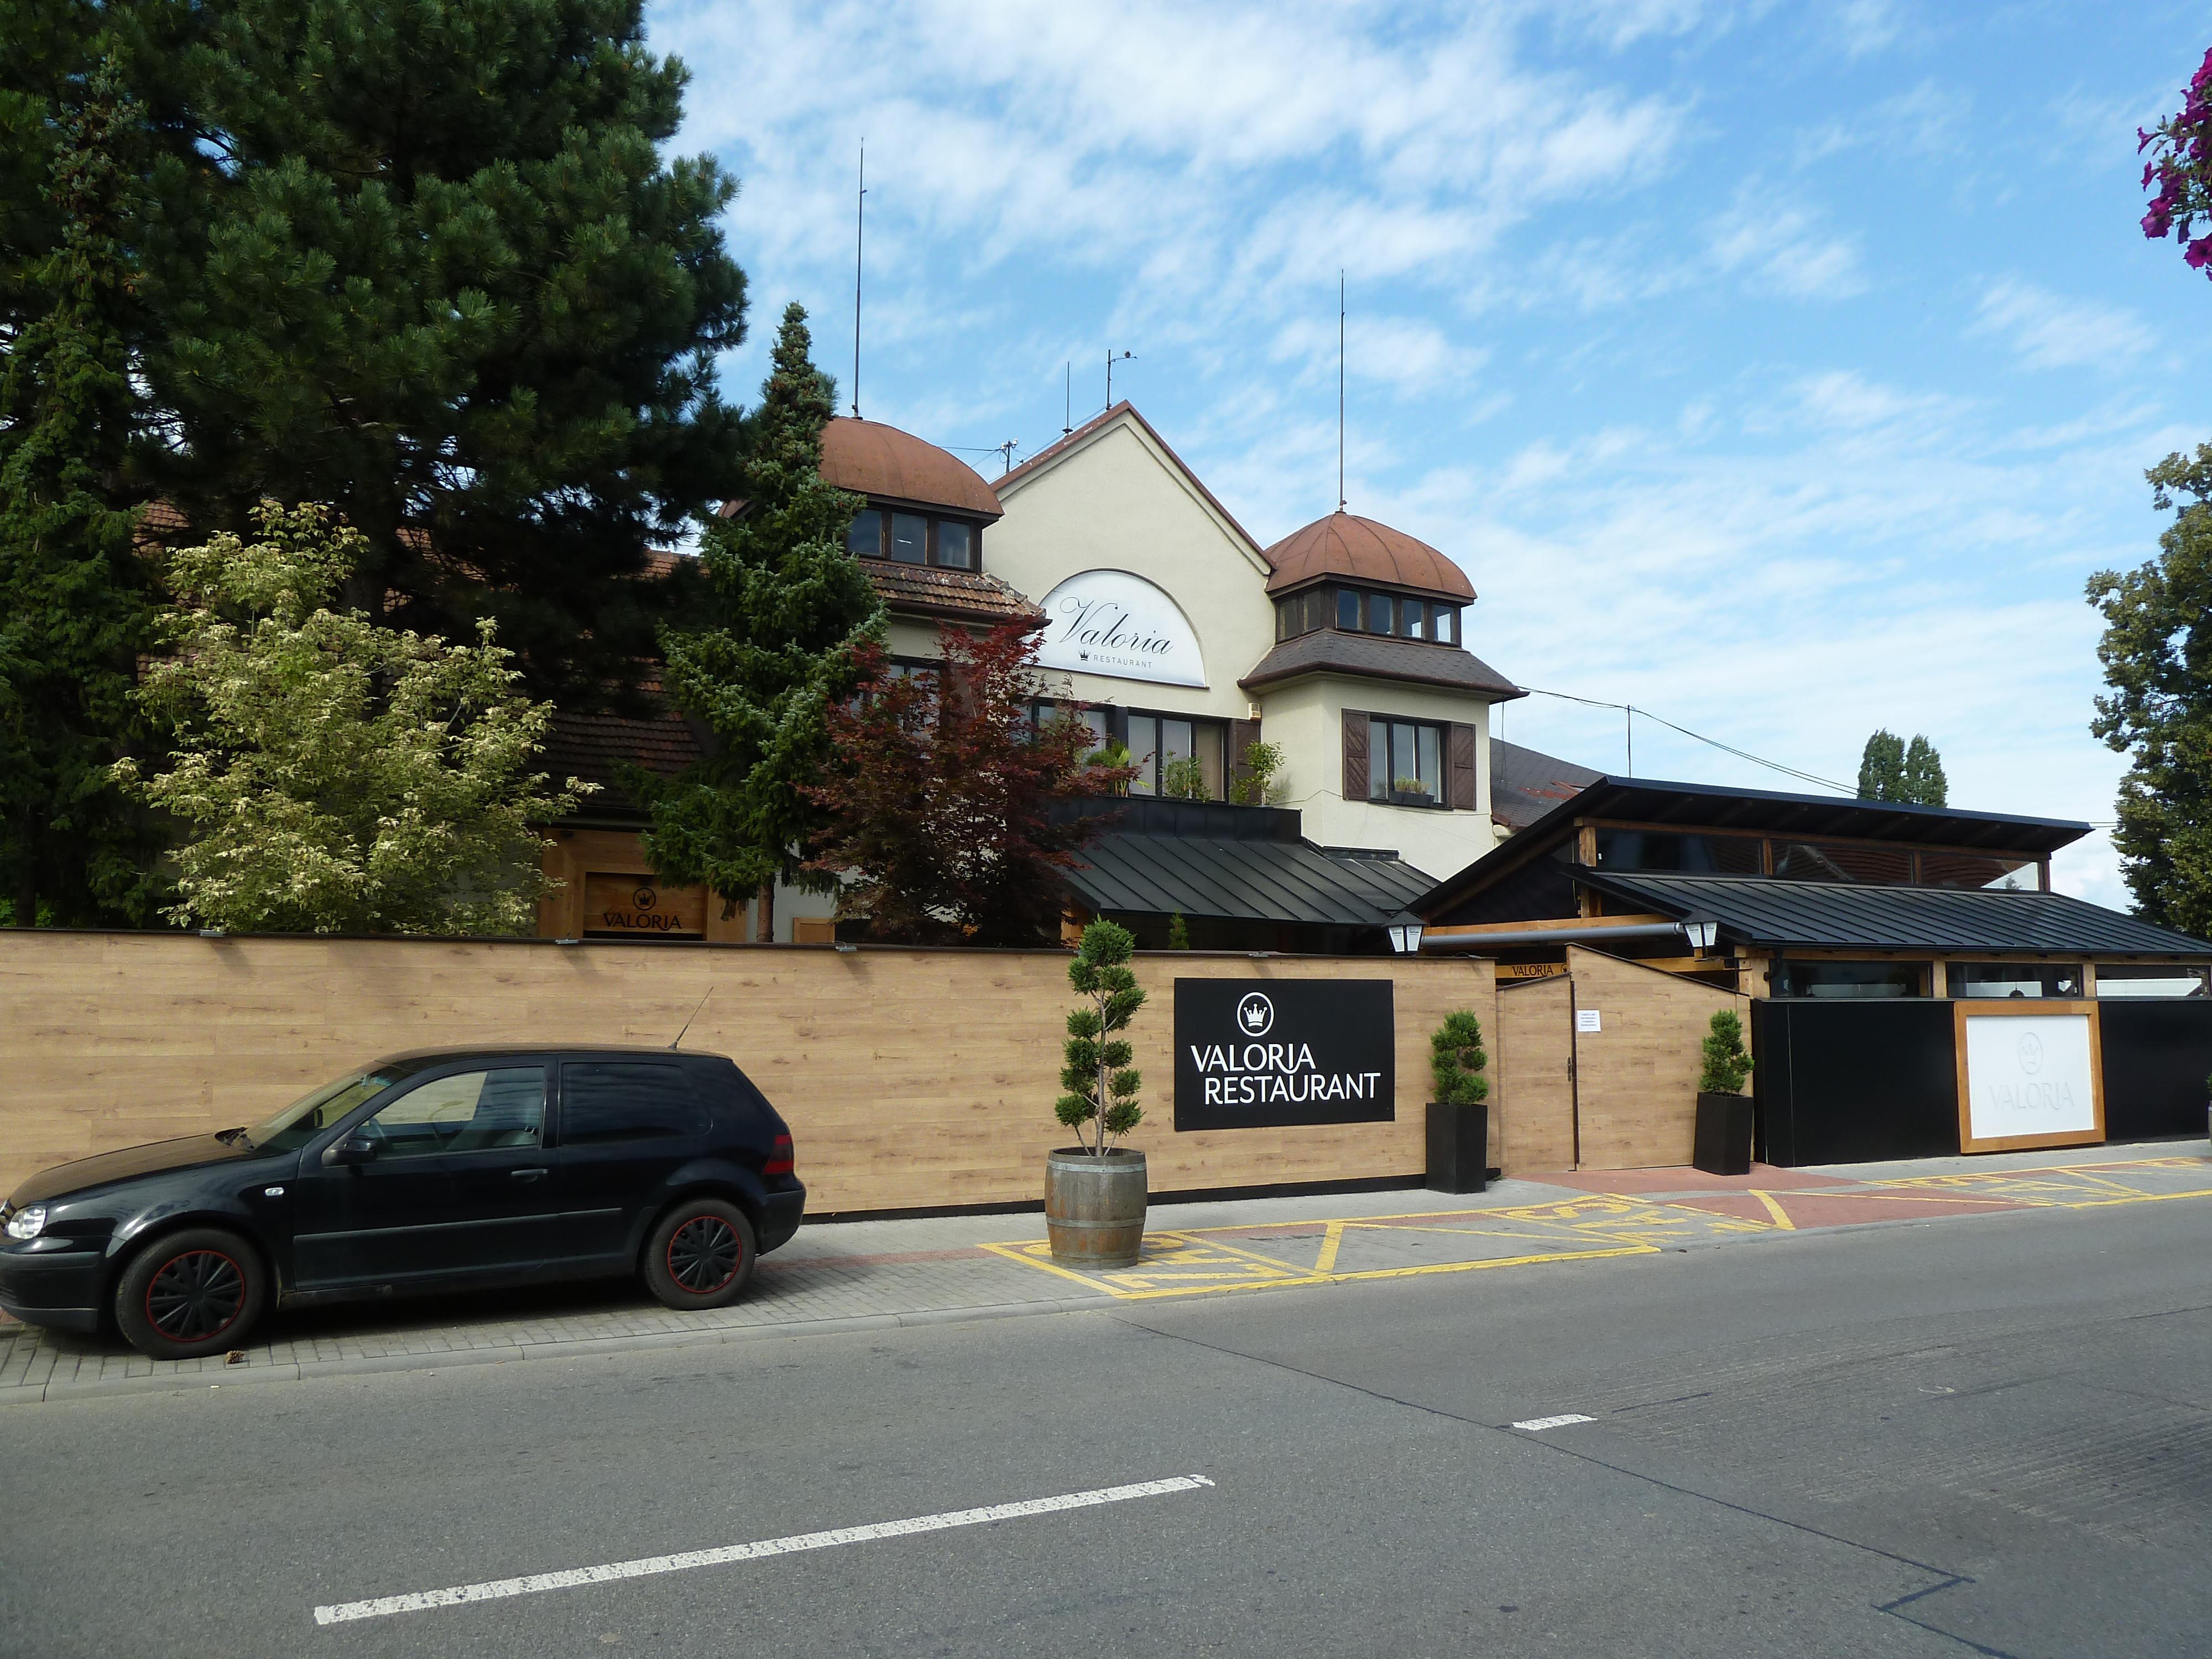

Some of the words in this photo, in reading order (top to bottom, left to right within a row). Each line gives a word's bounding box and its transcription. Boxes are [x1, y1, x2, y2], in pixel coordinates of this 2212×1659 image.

[1060, 597, 1173, 655] Valoria
[1093, 654, 1152, 668] RESTAURANT
[603, 913, 682, 931] VALORIA
[1512, 965, 1553, 977] VALORIA
[1190, 1043, 1316, 1074] VALORIA
[1204, 1072, 1381, 1105] RESTAURANT
[1987, 1081, 2074, 1111] VALORIA
